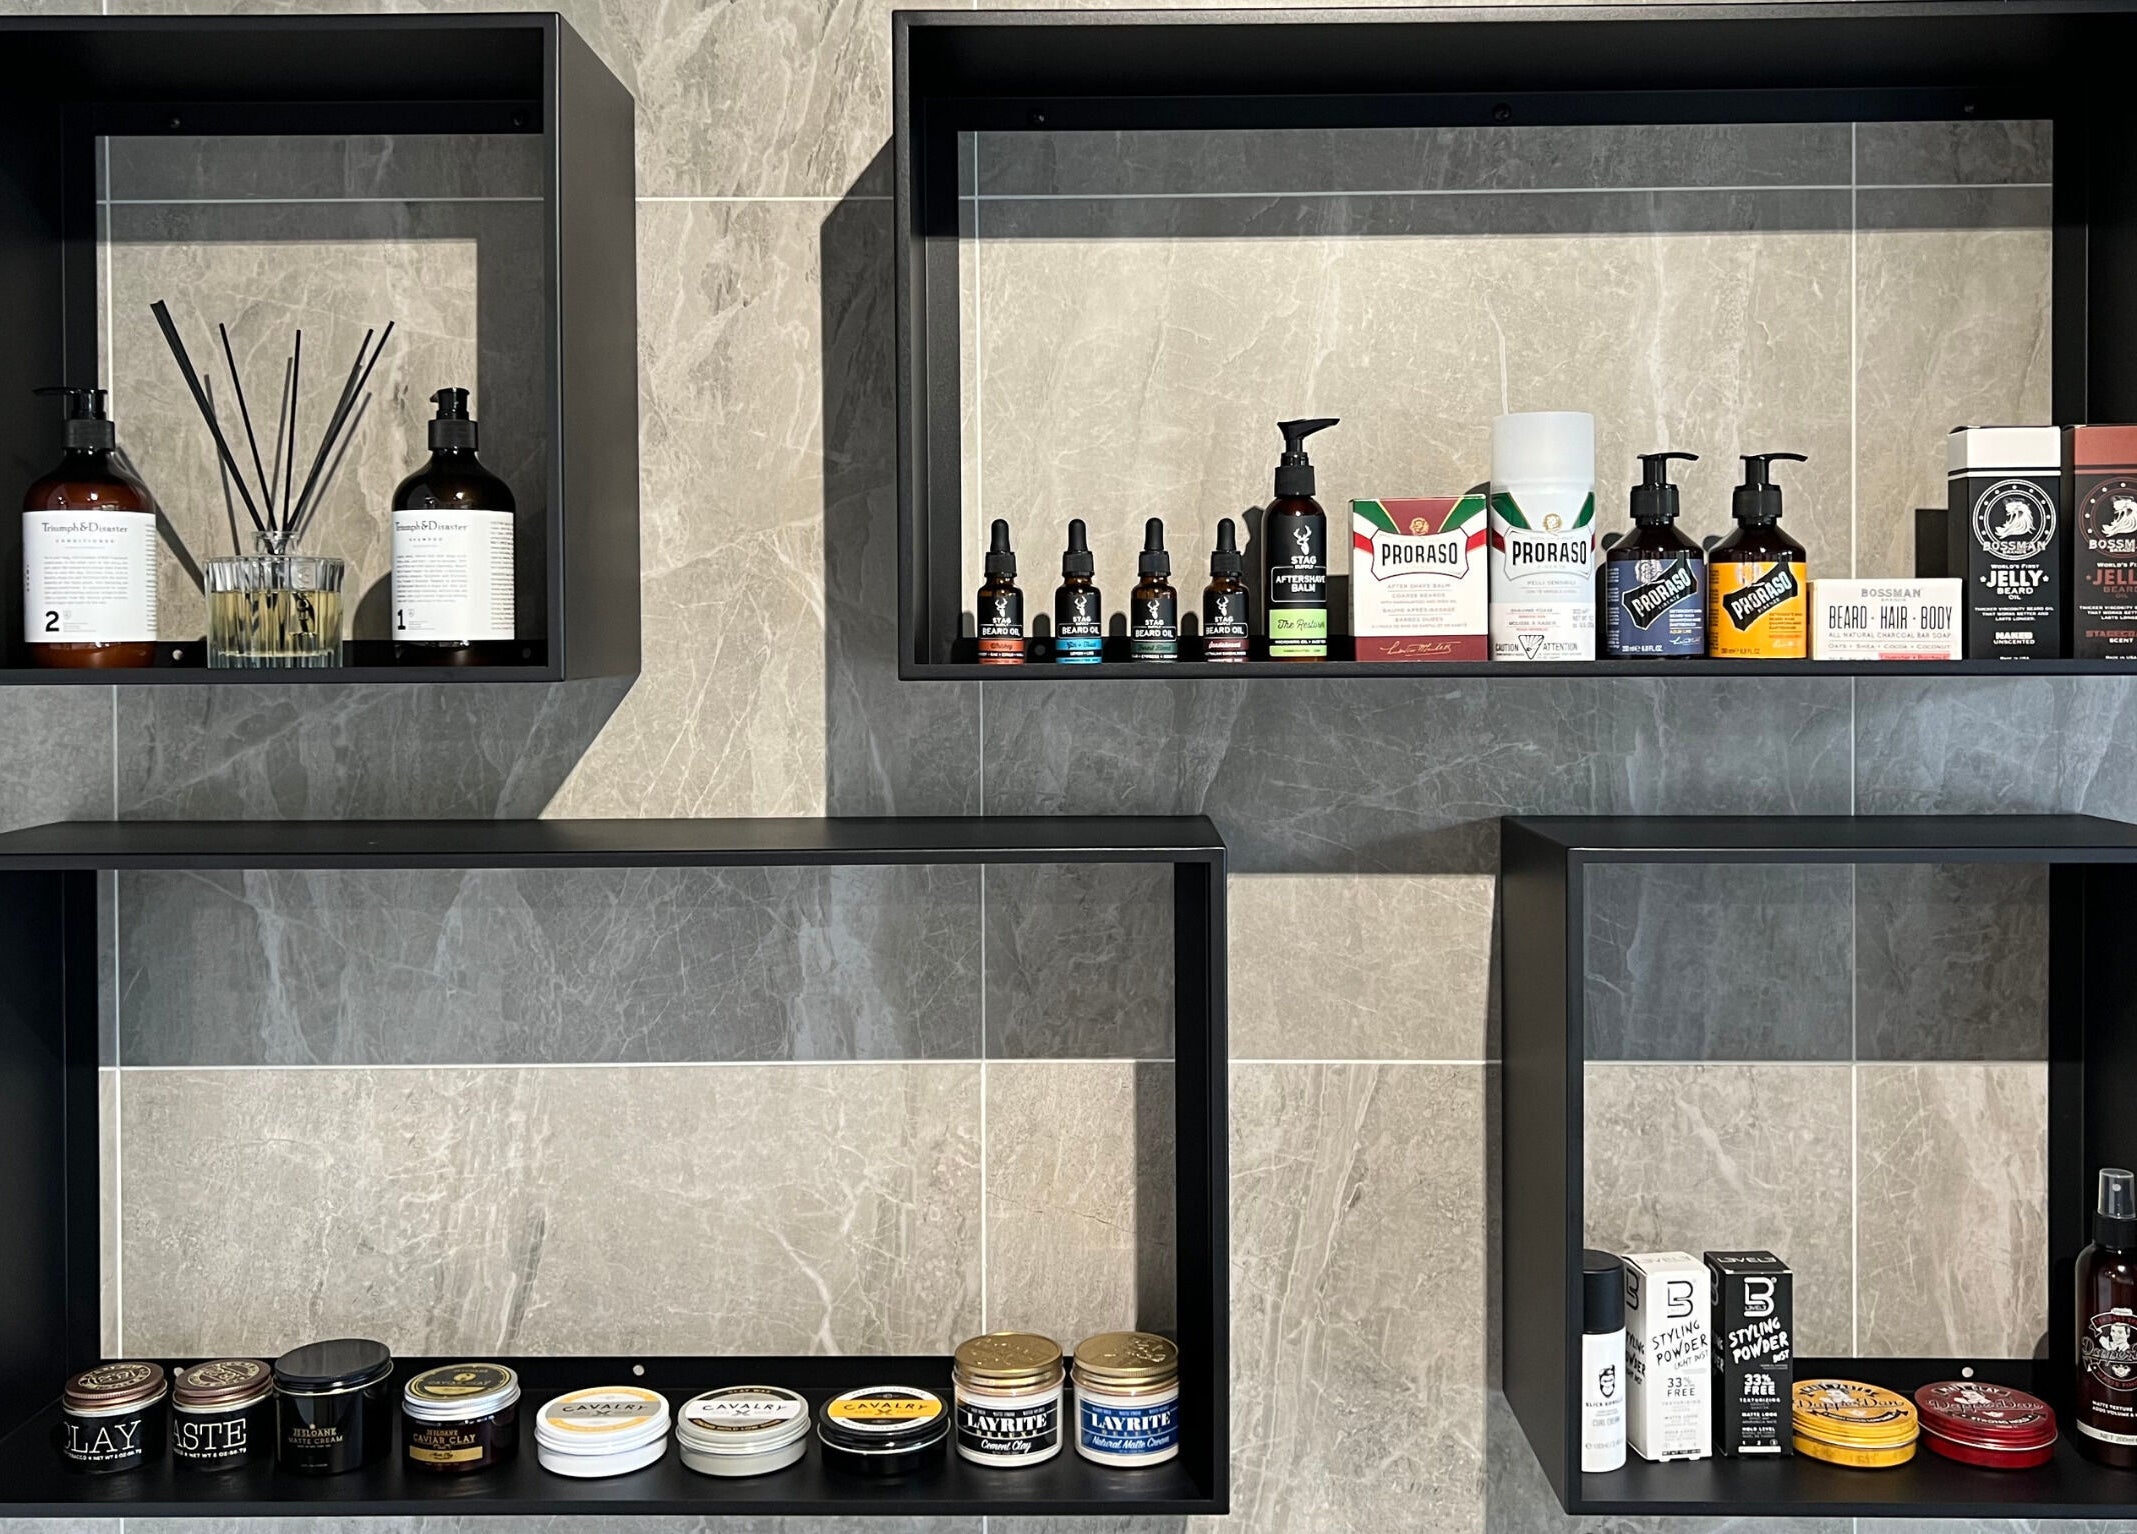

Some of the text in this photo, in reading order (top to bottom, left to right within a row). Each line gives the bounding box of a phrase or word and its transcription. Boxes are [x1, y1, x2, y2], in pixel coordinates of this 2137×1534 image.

[1983, 541, 2046, 551] BOSSMAN
[2088, 539, 2137, 550] BOSSM
[1382, 542, 1458, 566] PRORASO
[1512, 540, 1587, 566] PRORASO
[1291, 555, 1317, 565] STAG
[1986, 569, 2044, 587] JELLY
[1291, 584, 1316, 592] BALM
[1631, 567, 1691, 617] PRORASO
[1861, 588, 1921, 598] BOSSMAN
[1997, 587, 2034, 595] BEARD
[1731, 570, 1792, 621] PRORASO
[45, 610, 60, 632] 2
[397, 609, 406, 630] 1
[1829, 605, 1952, 630] BEARD HAIR BODY
[1277, 619, 1294, 629] The
[982, 627, 1020, 636] BEARD OIL
[1061, 626, 1100, 635] BEARD OIL
[1135, 629, 1173, 638] BEARD OIL
[1206, 626, 1244, 635] BEARD OIL
[1495, 643, 1578, 651] CAUTION ATTENTION
[1652, 1320, 1700, 1350] STYLING
[1728, 1316, 1781, 1348] STYLING
[1656, 1333, 1708, 1366] POWDER
[1732, 1331, 1790, 1364] POWDER
[1773, 1349, 1789, 1363] DUST
[1744, 1374, 1774, 1386] 33%
[1667, 1388, 1696, 1397] FREE
[1744, 1385, 1776, 1395] FREE
[562, 1403, 648, 1413] CAVALRY
[702, 1402, 787, 1412] CAVALRY
[843, 1402, 928, 1410] CAVALRY
[967, 1410, 1047, 1434] LAYRITE
[1091, 1411, 1171, 1434] LAYRITE
[413, 1433, 477, 1445] CAVIAR CLAY
[1092, 1436, 1121, 1449] Natural
[1122, 1439, 1146, 1449] Matte
[981, 1439, 1032, 1454] Cement Clay
